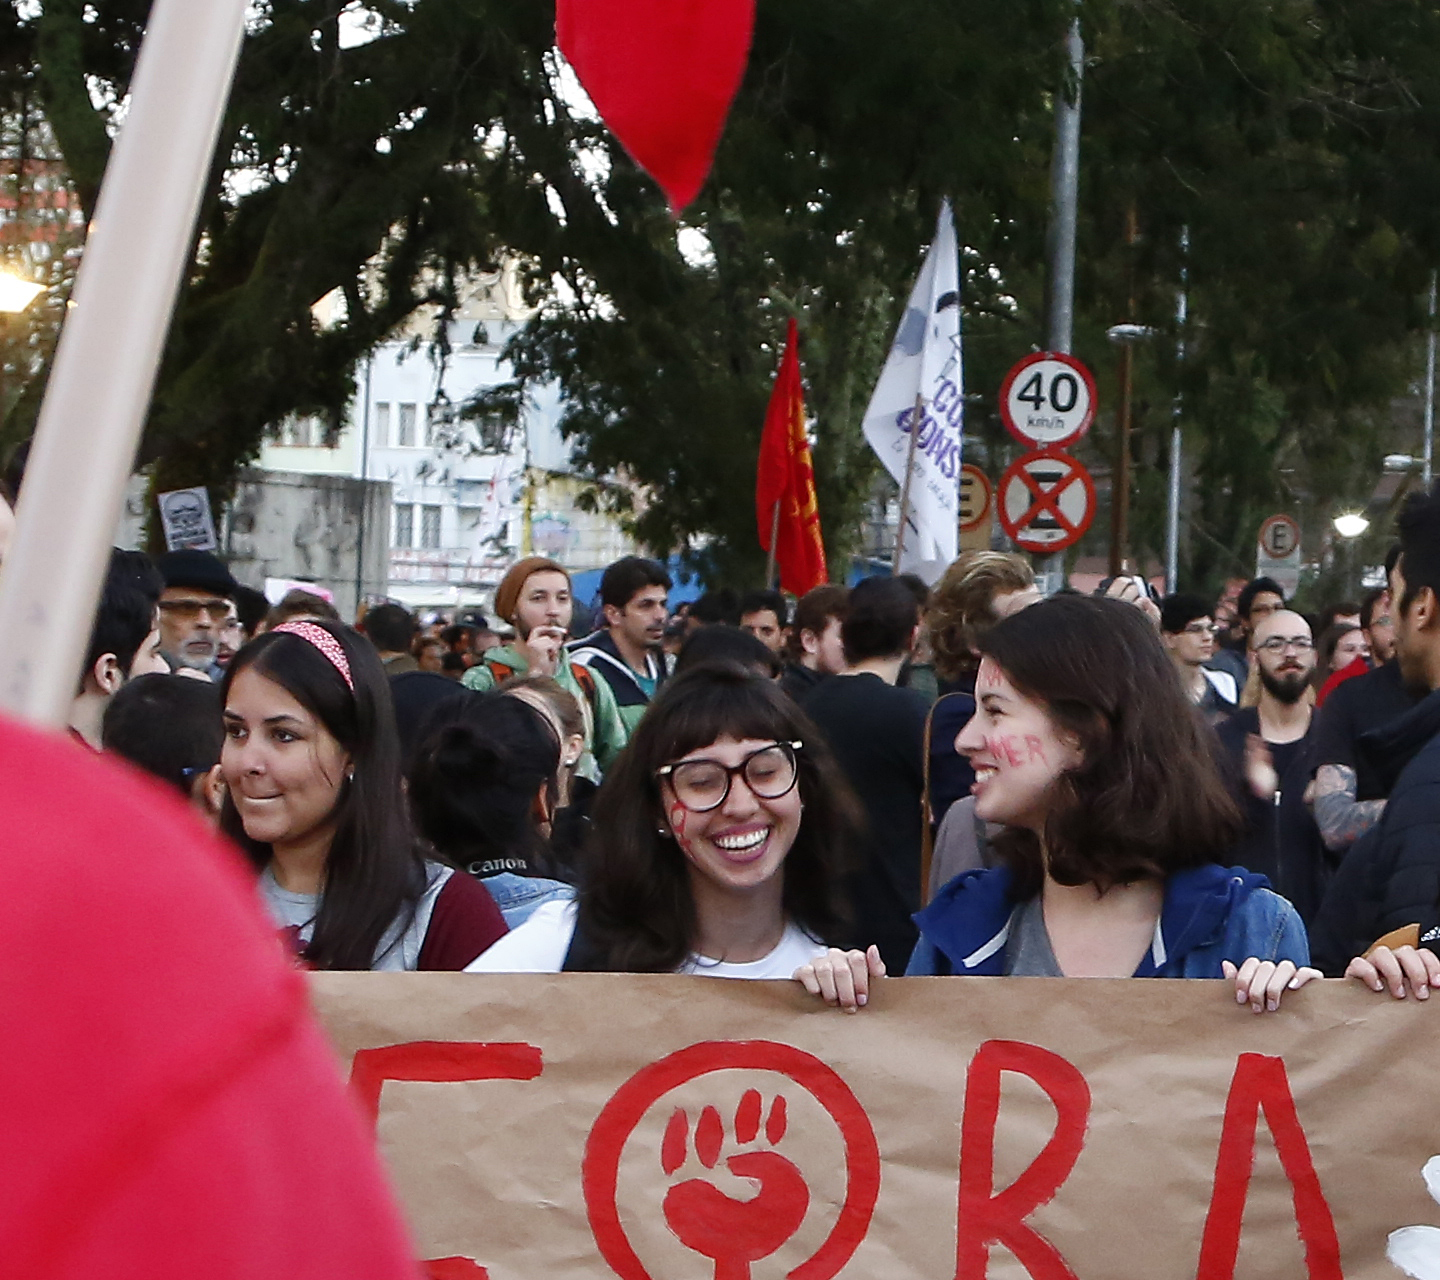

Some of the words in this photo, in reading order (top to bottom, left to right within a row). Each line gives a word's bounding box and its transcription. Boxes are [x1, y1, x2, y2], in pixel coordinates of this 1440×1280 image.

[1016, 372, 1078, 412] 40
[1027, 415, 1065, 429] km/h
[1273, 524, 1286, 549] E
[468, 858, 527, 874] Canon
